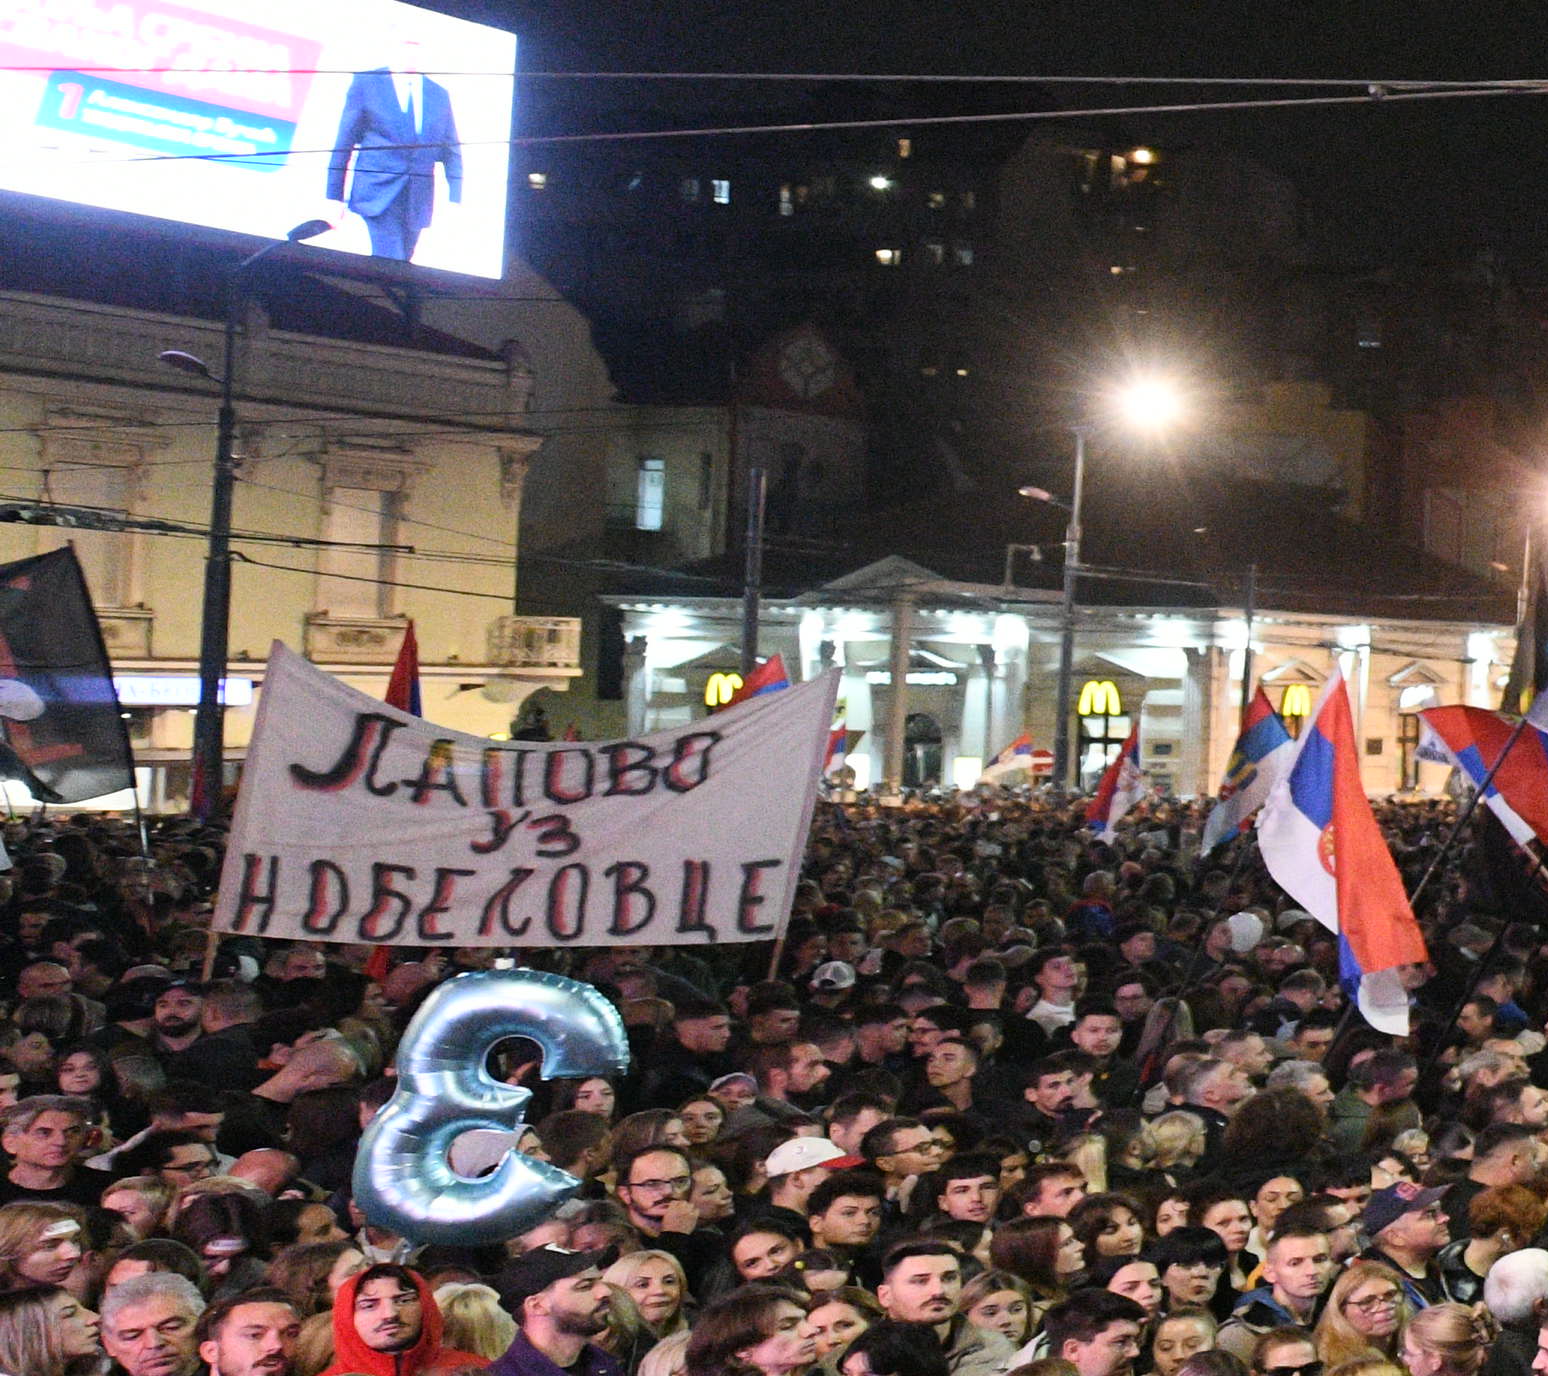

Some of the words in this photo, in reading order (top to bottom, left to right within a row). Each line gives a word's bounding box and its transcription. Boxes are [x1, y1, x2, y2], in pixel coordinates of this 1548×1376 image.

[290, 712, 722, 809] ЛАПОВО
[470, 810, 581, 858] УЗ
[231, 853, 782, 942] НОБЕЛОВЦЕ
